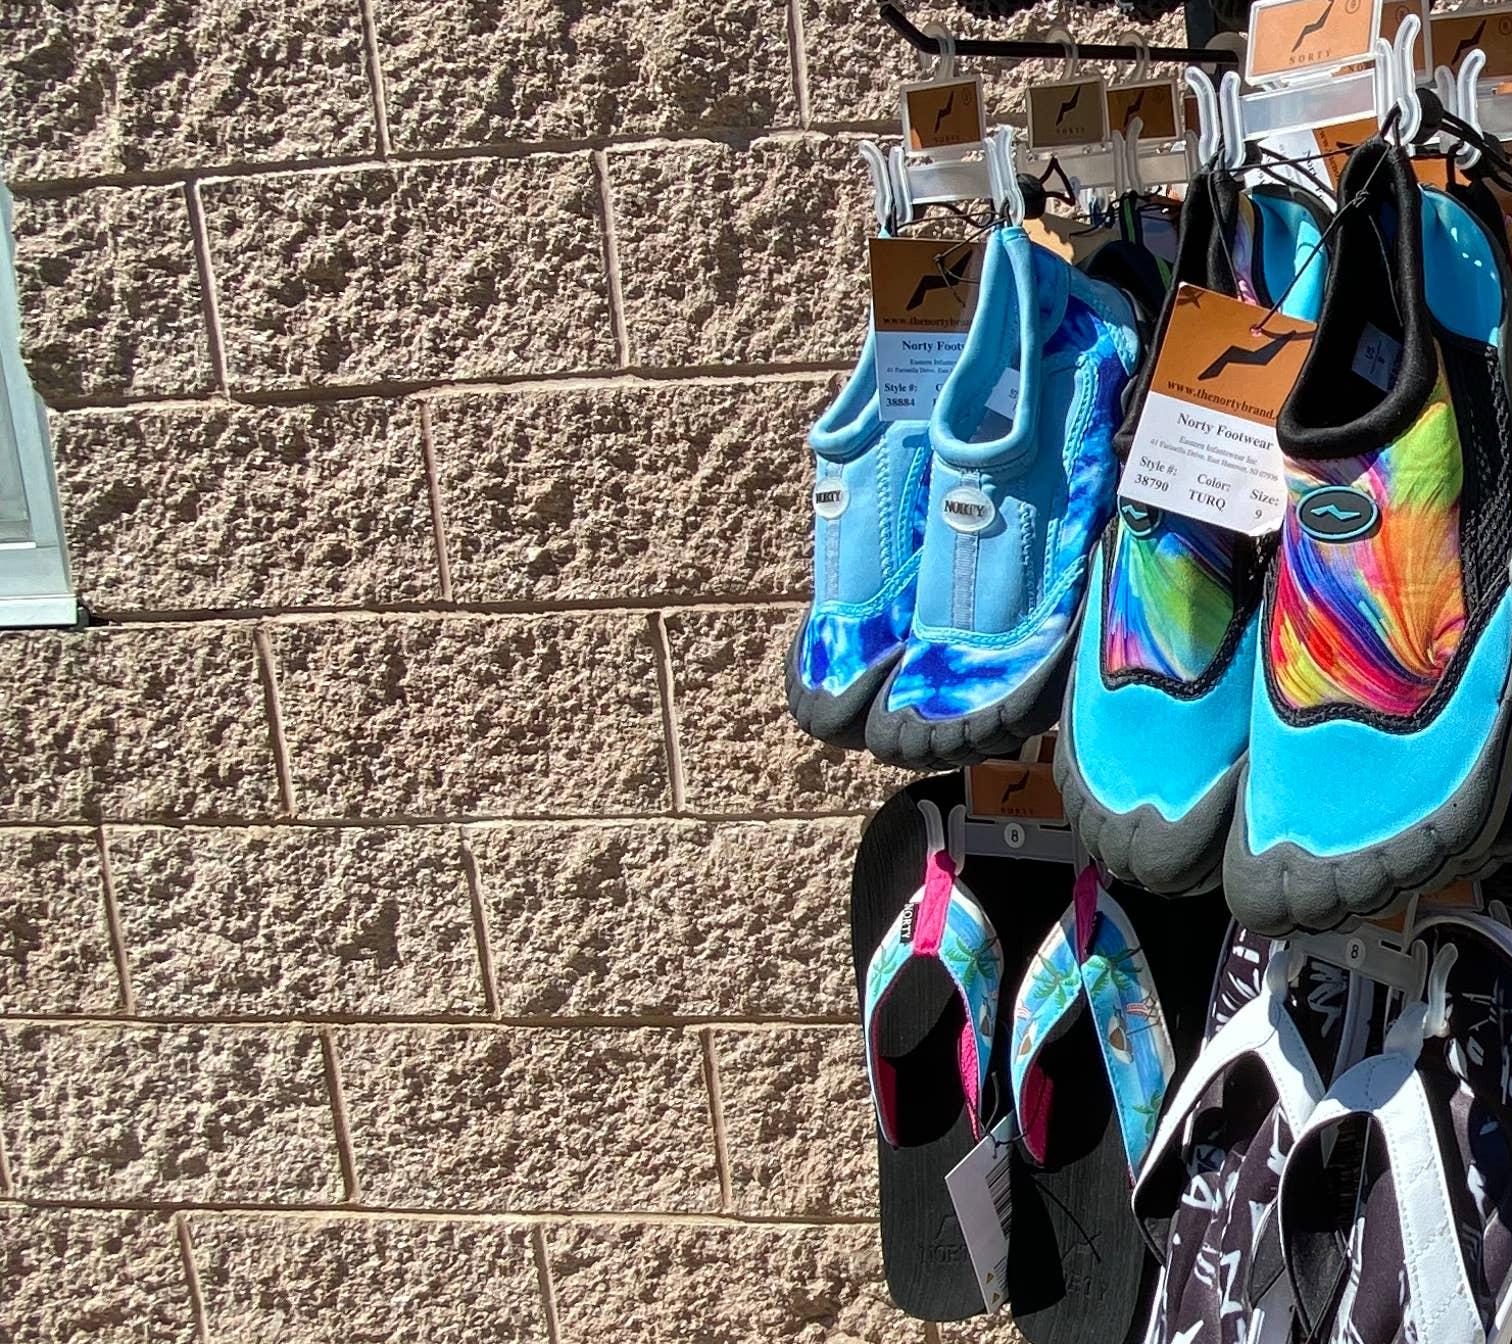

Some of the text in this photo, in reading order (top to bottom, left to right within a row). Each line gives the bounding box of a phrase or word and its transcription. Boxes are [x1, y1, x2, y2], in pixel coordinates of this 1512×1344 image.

[1288, 48, 1331, 65] NORTY
[902, 340, 933, 352] Norty
[884, 382, 906, 394] Style
[1167, 380, 1276, 420] www.thenortybrand.
[1177, 412, 1275, 451] Norty Footwear
[1139, 456, 1165, 474] Style
[1197, 473, 1232, 493] Color:
[1250, 488, 1280, 507] Size:
[1134, 473, 1263, 520] 38790 TURQ 9
[943, 500, 985, 518] NORTY
[1010, 828, 1020, 843] 8
[900, 902, 916, 940] NORTY
[1350, 943, 1360, 960] 8
